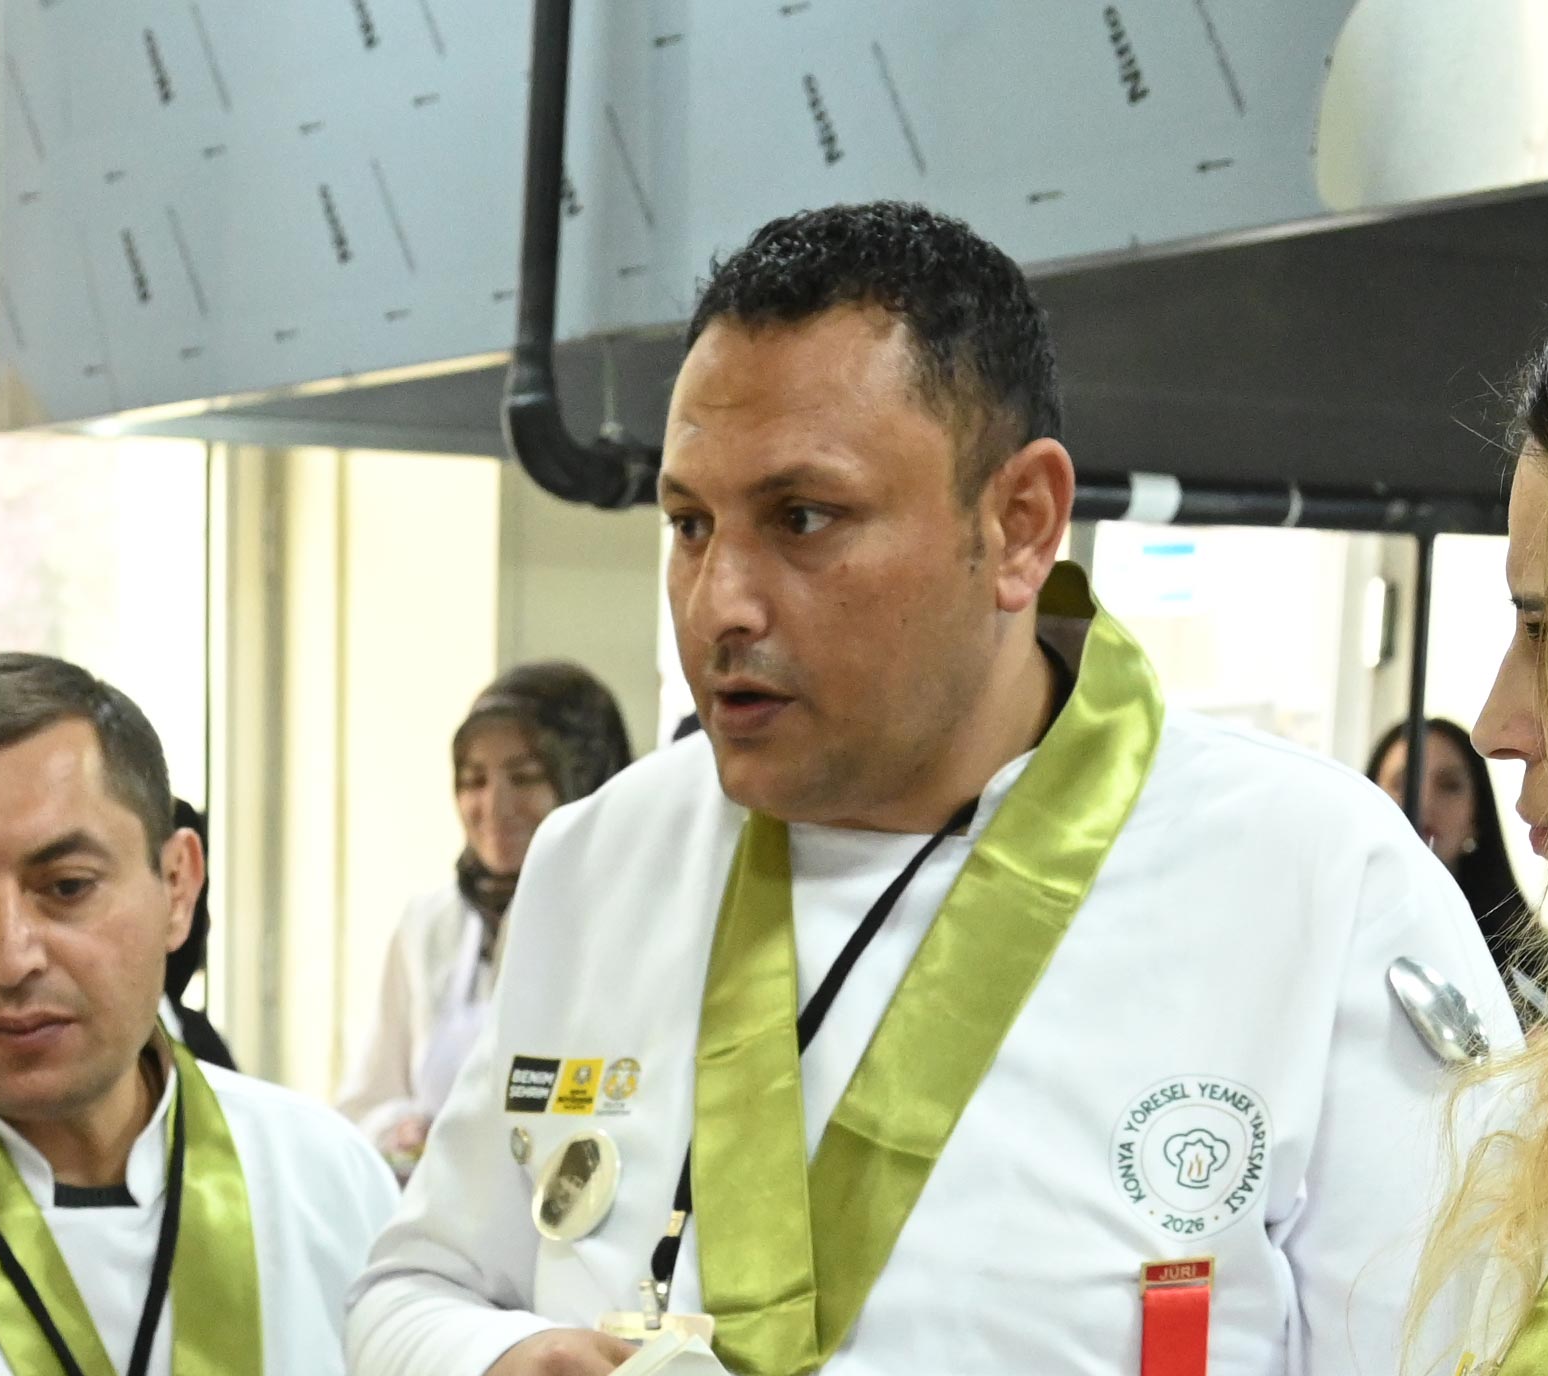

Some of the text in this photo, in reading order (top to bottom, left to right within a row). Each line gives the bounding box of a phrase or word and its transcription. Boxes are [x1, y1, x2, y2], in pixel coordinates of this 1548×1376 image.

[1117, 1082, 1266, 1215] KONYA YÖRESEL YEMEK YARIŞMASI
[1161, 1213, 1205, 1235] 2026
